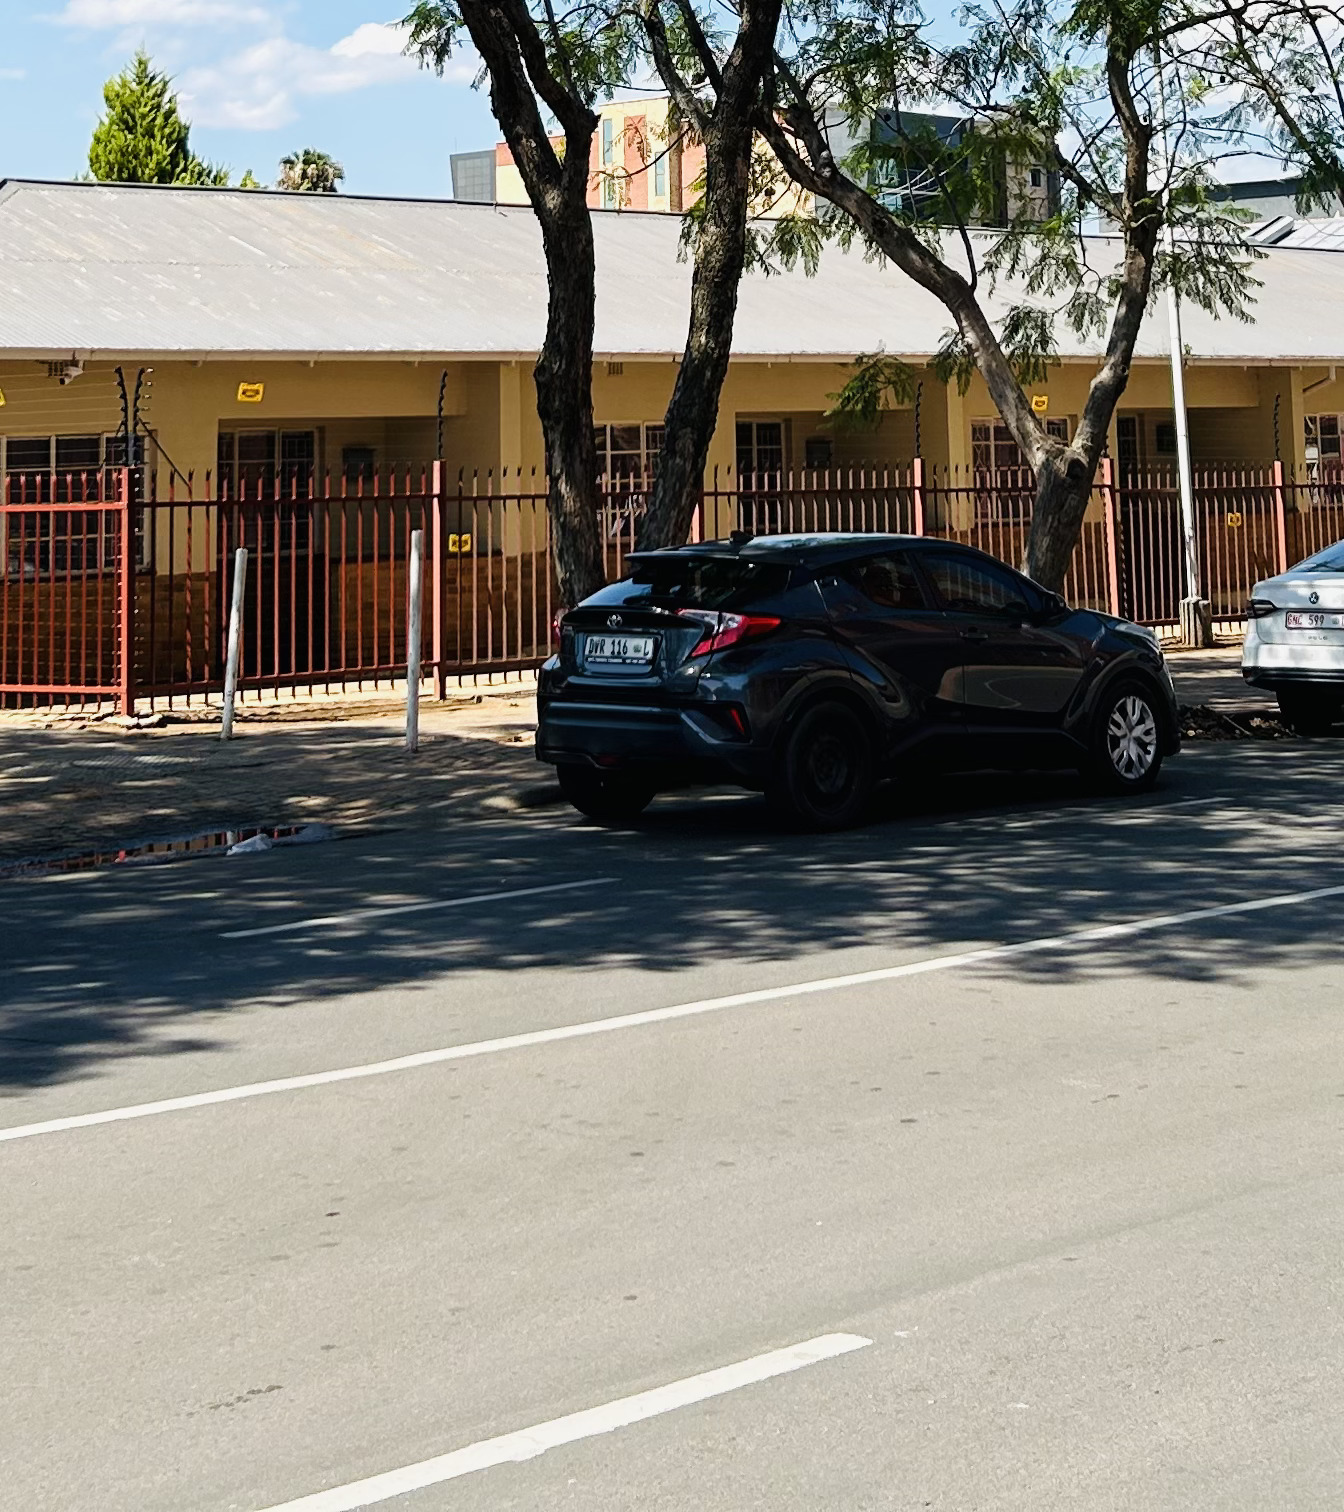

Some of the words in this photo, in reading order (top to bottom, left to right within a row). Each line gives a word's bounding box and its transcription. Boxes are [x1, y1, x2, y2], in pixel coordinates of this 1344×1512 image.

[1308, 614, 1325, 626] 599
[610, 639, 628, 656] 116
[643, 640, 650, 656] L
